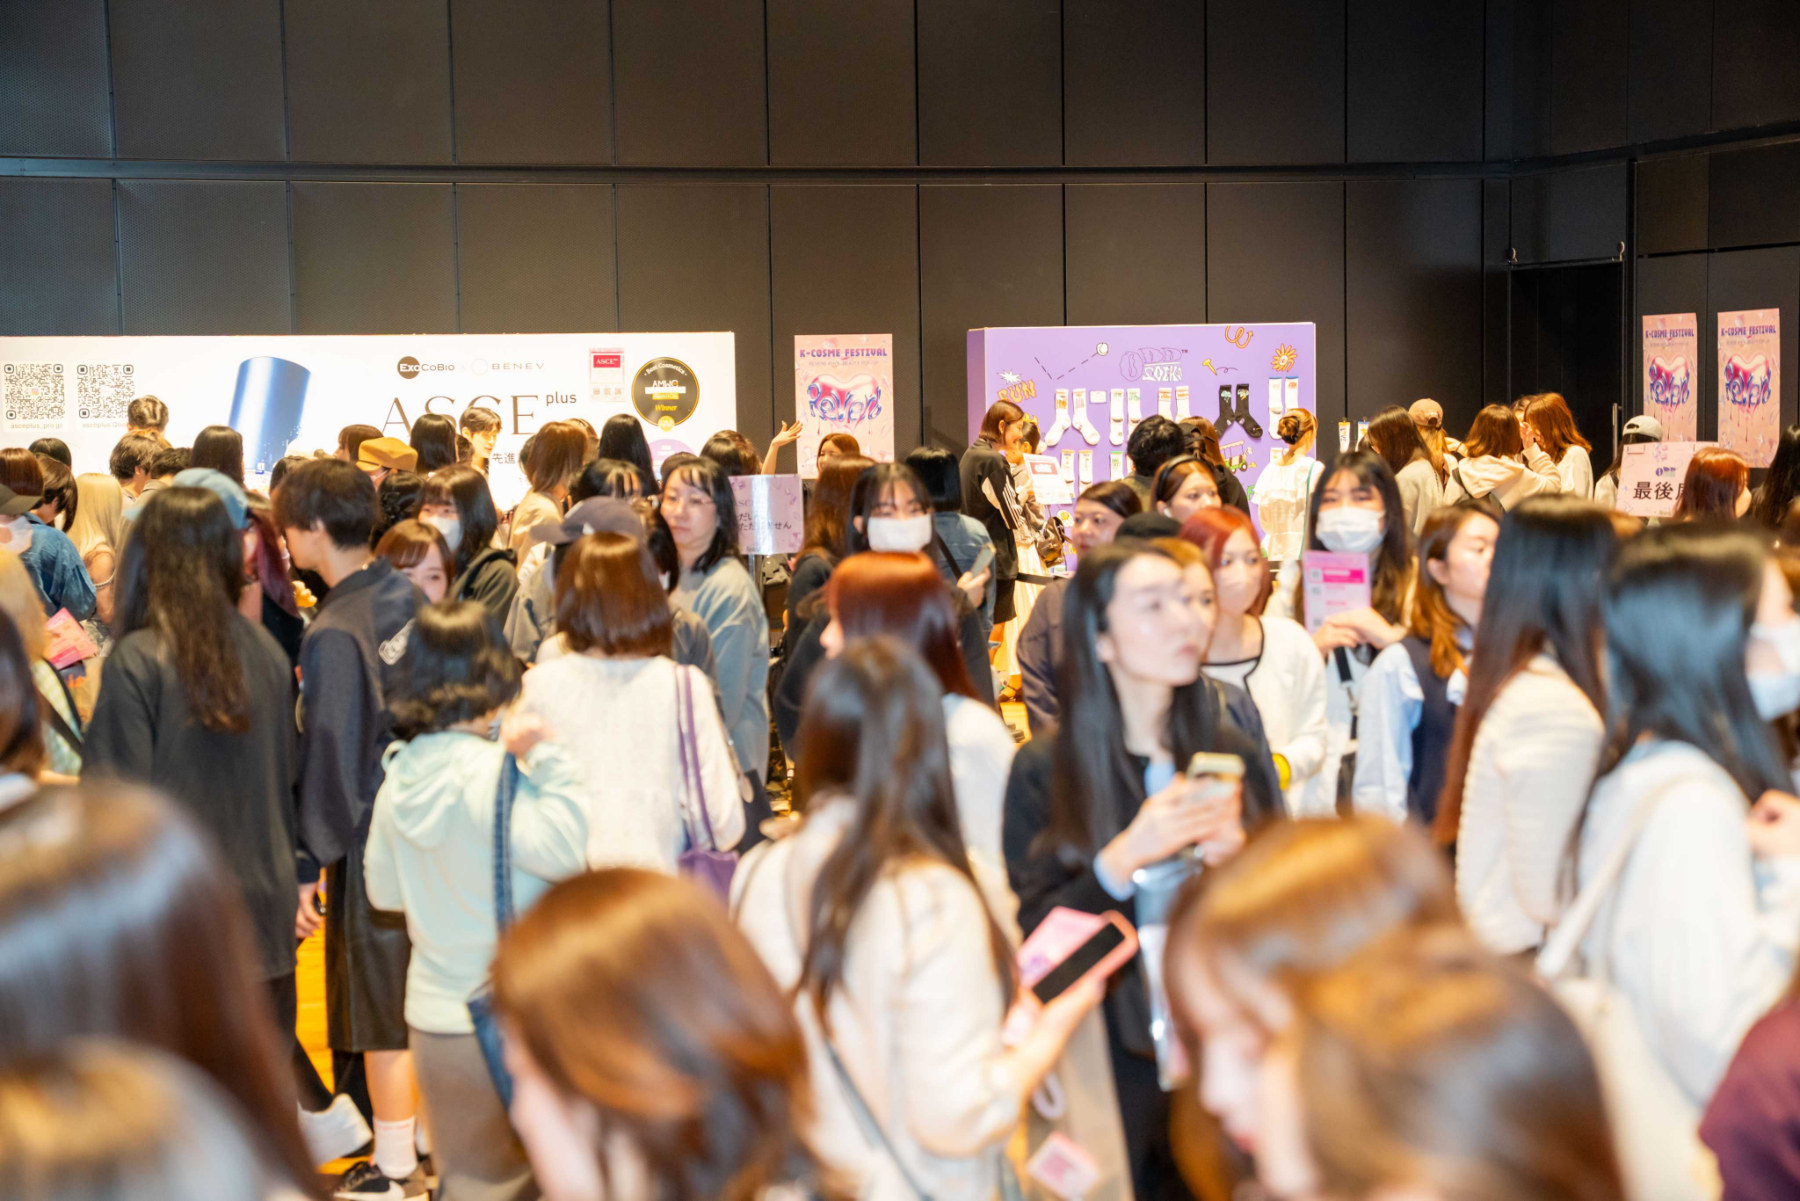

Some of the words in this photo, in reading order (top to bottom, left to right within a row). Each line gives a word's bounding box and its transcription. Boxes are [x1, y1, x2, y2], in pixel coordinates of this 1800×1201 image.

[1669, 327, 1695, 338] FESTIVAL
[1721, 326, 1746, 337] K-COSME
[1749, 324, 1777, 335] FESTIVAL
[800, 348, 840, 358] K-COSME
[845, 347, 888, 357] FESTIVAL
[491, 362, 545, 370] BENEV
[545, 391, 577, 406] plus
